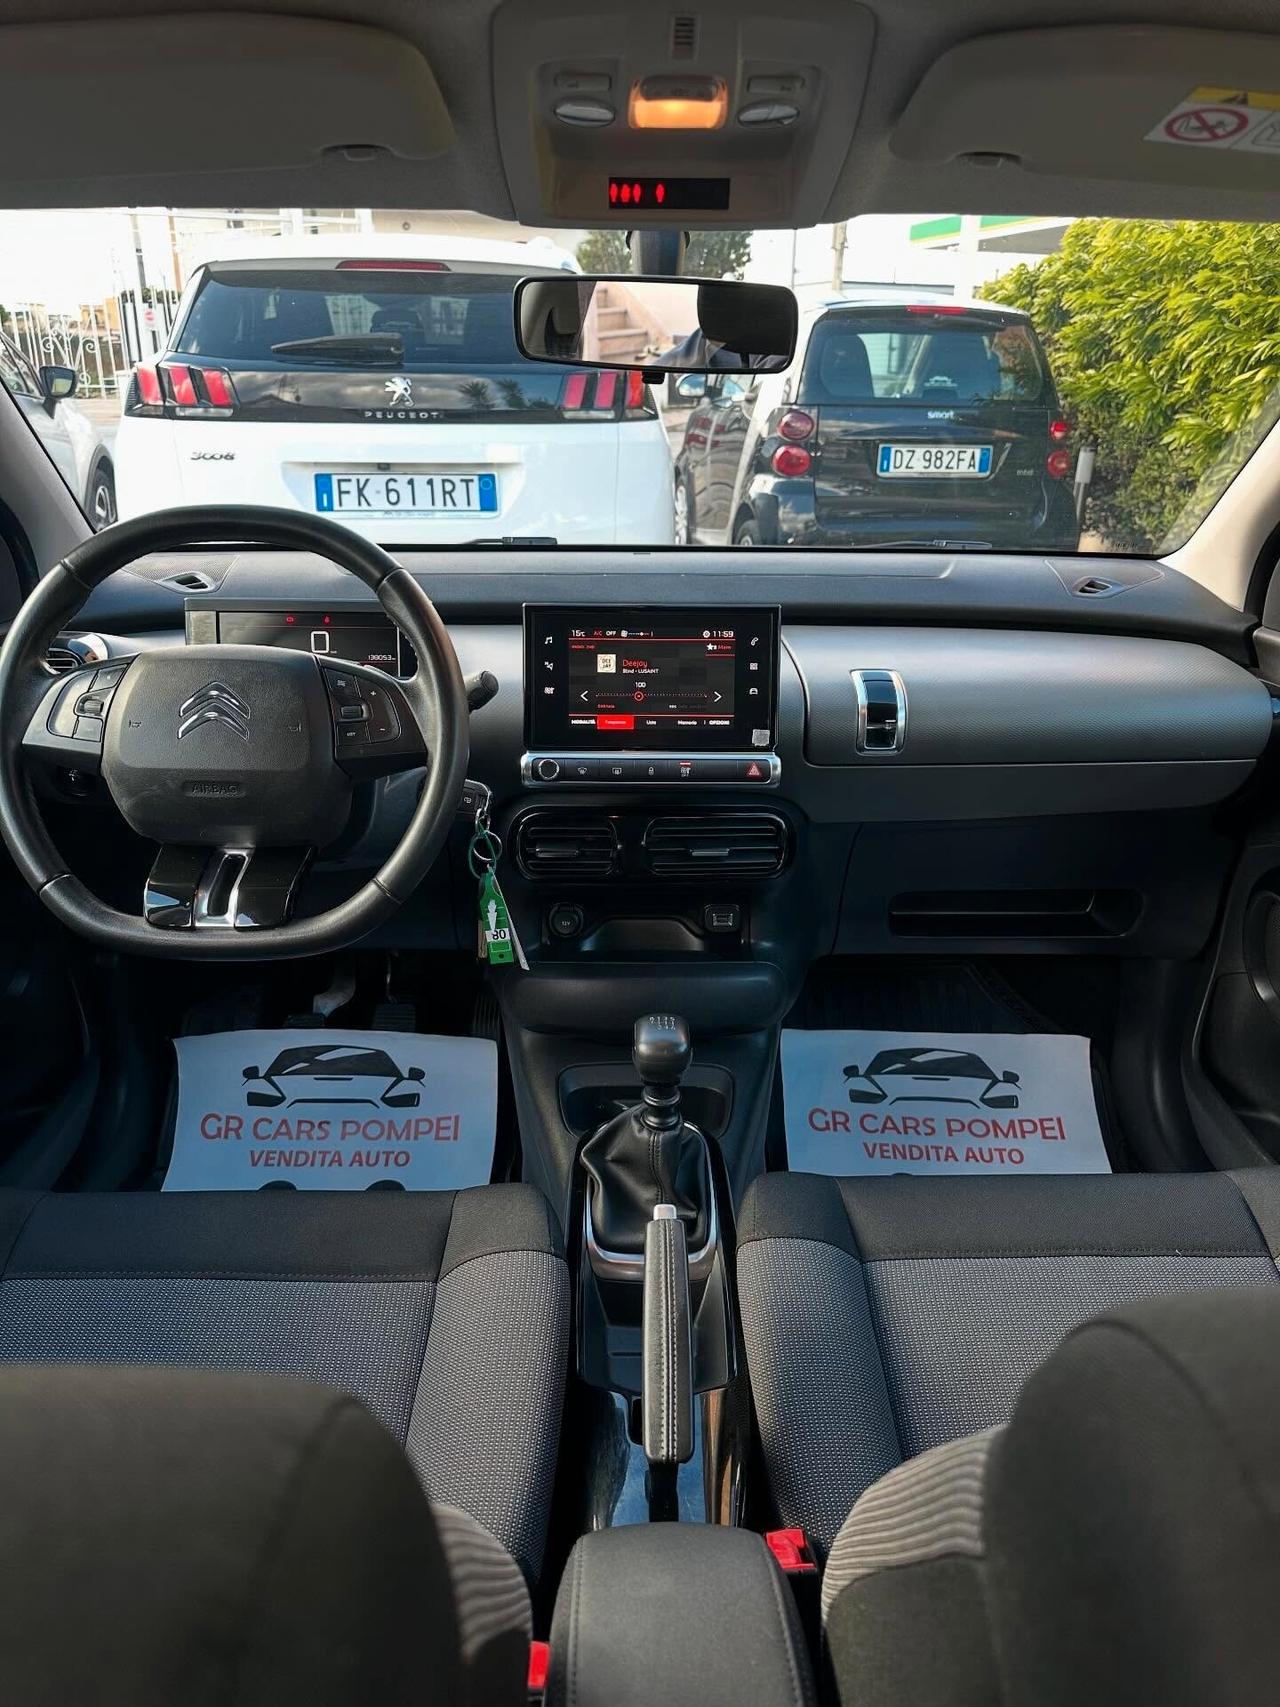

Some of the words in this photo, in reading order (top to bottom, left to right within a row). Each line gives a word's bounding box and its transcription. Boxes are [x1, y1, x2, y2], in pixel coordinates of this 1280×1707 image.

[364, 411, 439, 419] PEUGEOT
[927, 411, 954, 420] smart
[190, 452, 236, 461] 3008
[893, 450, 915, 469] DZ
[922, 450, 976, 470] 982FA
[336, 478, 372, 507] FK
[385, 478, 475, 507] 611RT
[712, 630, 734, 638] 11:59
[199, 1112, 244, 1140] GR
[252, 1116, 331, 1141] CARS
[340, 1114, 461, 1142] POMPEI
[807, 1107, 852, 1133] GR
[858, 1112, 937, 1137] CARS
[945, 1116, 1067, 1141] POMPEI
[250, 1149, 343, 1168] VENDITA
[348, 1150, 411, 1168] AUTO
[862, 1141, 957, 1163] VENDITA
[964, 1146, 1025, 1165] AUTO
